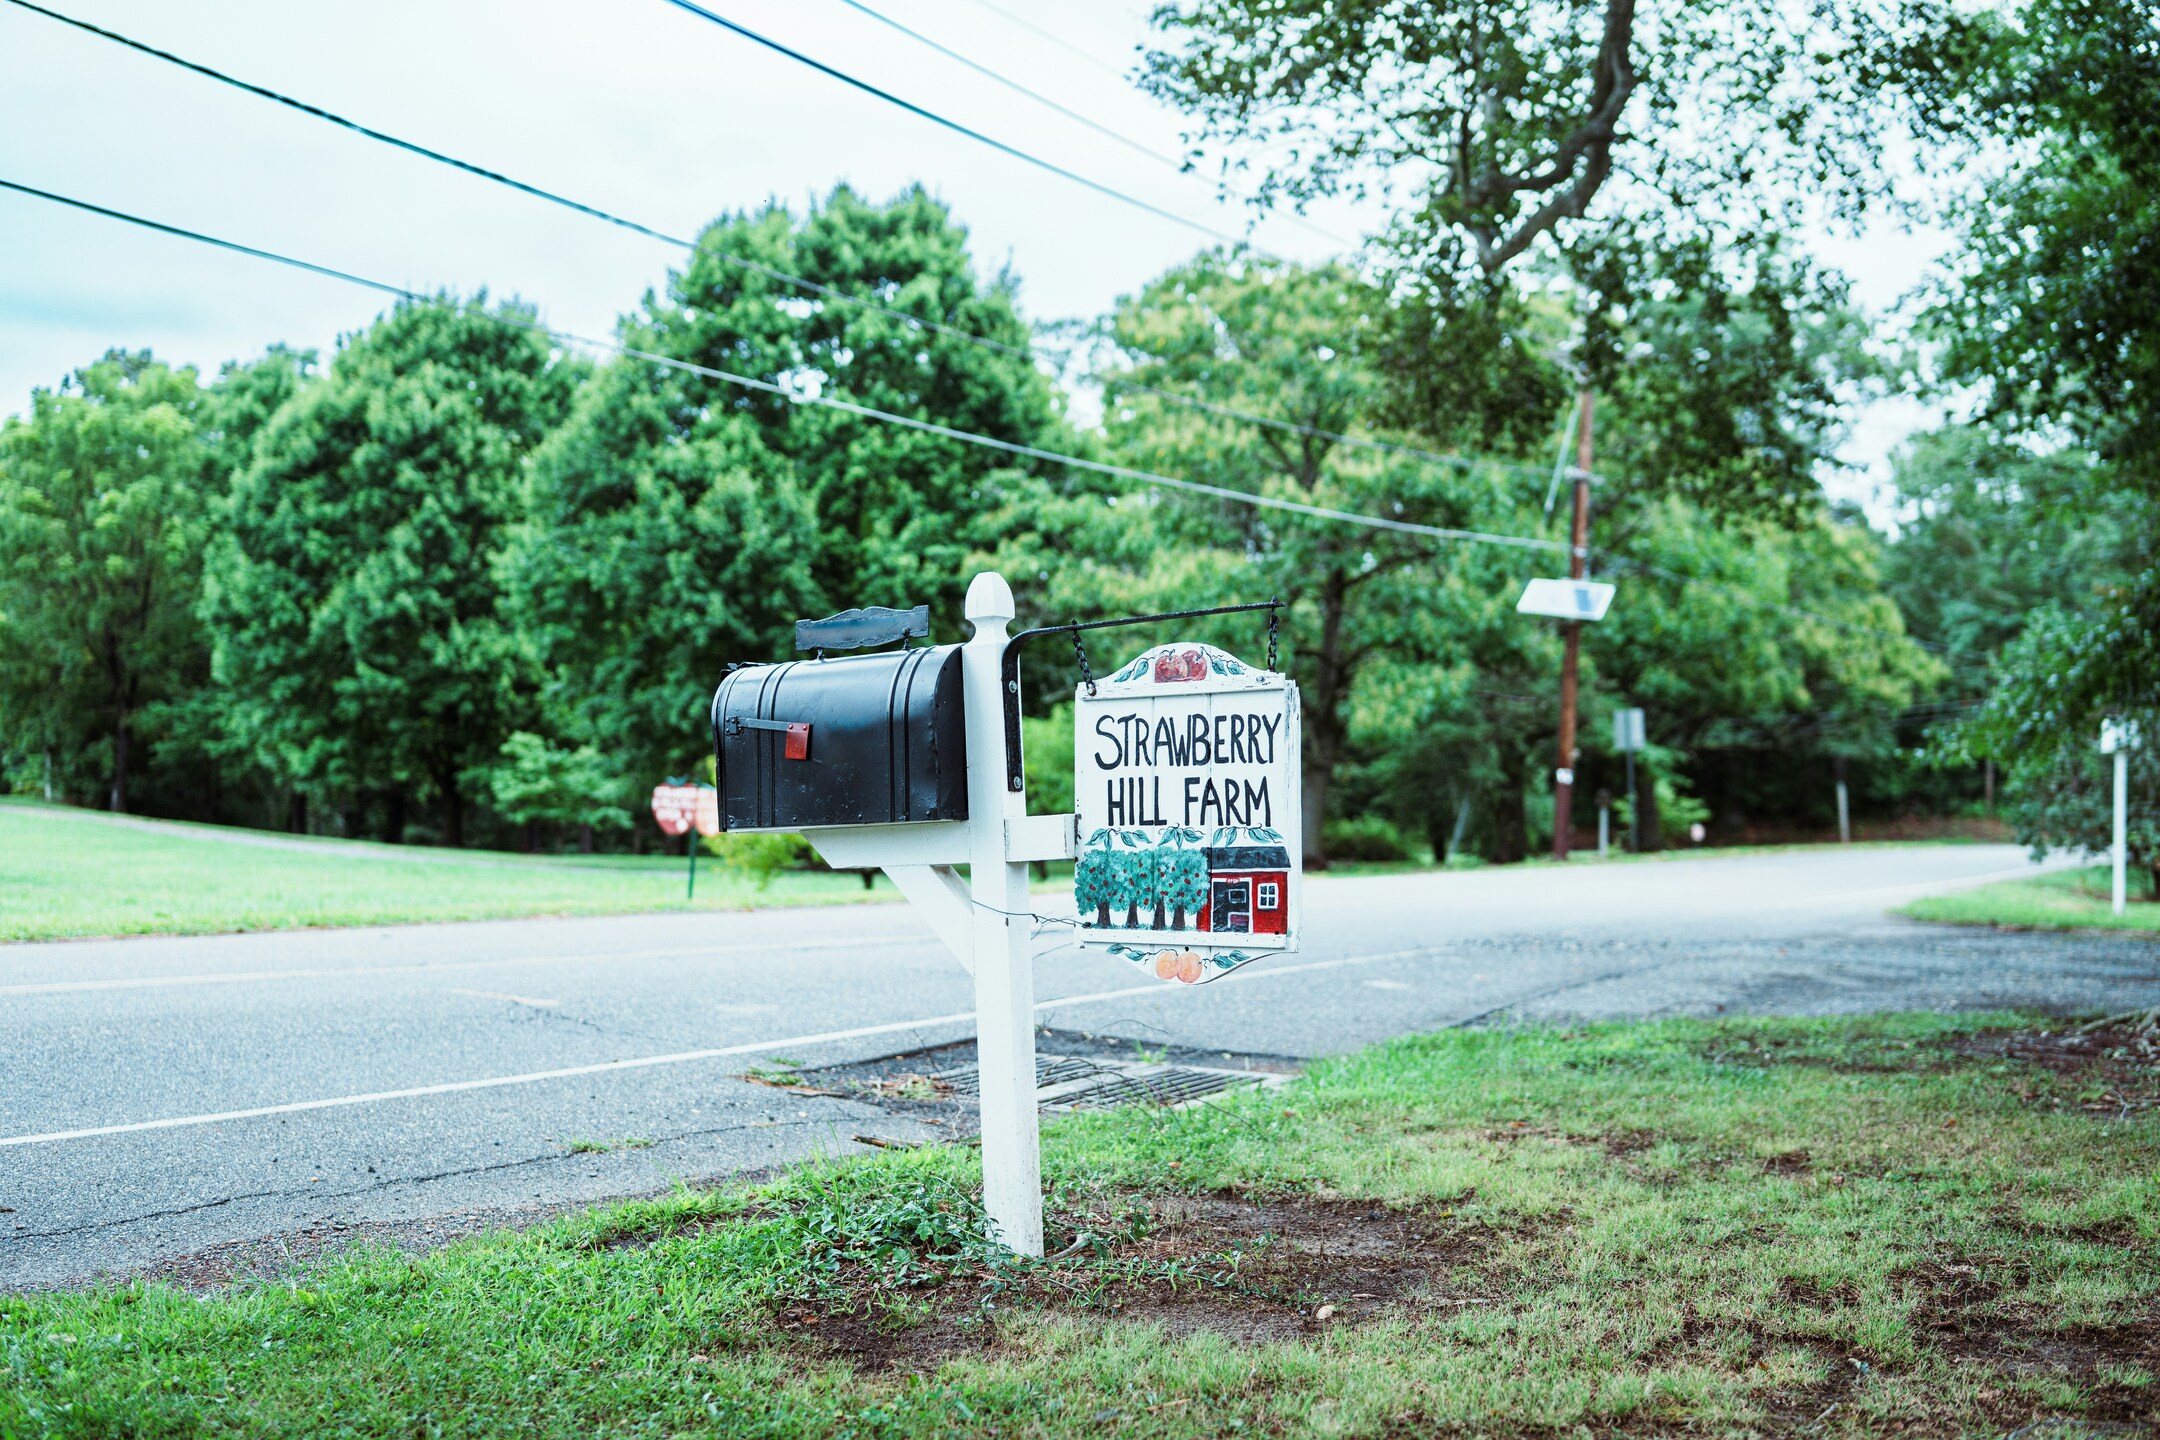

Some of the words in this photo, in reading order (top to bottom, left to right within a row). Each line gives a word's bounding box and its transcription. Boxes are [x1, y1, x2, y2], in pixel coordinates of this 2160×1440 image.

[1094, 713, 1282, 770] STRAWBERRY
[1107, 776, 1168, 826] HILL
[1184, 776, 1272, 827] FARM
